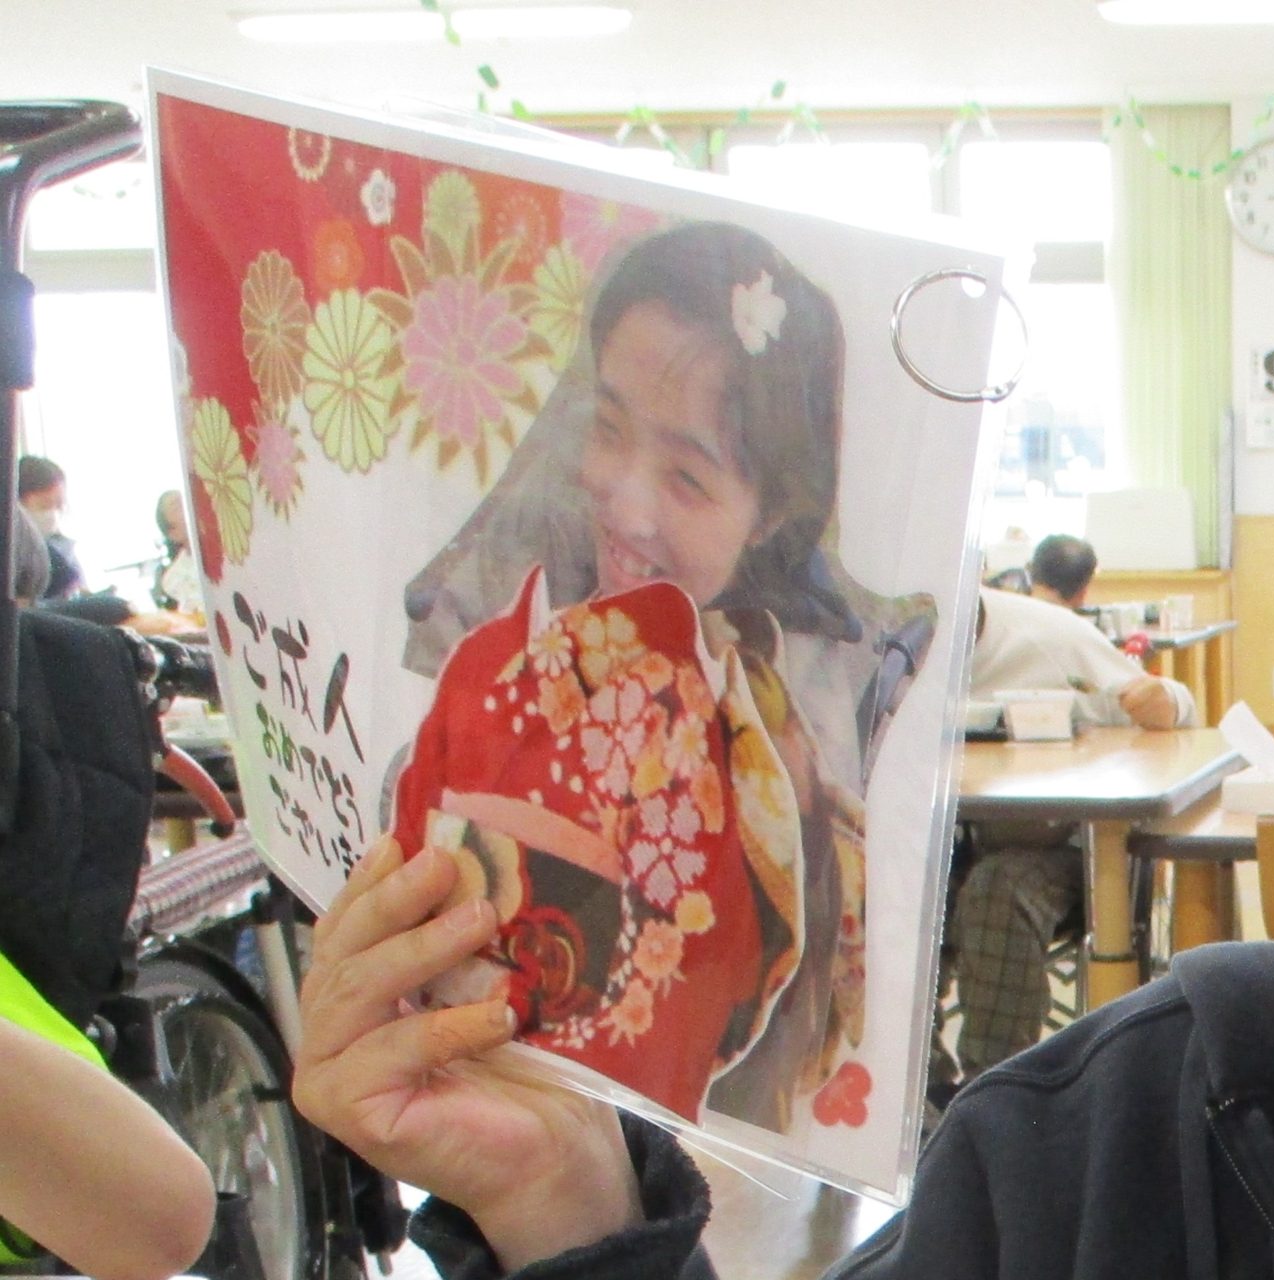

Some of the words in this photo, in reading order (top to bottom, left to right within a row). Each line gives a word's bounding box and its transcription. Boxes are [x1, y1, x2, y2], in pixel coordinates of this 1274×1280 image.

[233, 591, 364, 764] ご成人
[256, 701, 364, 844] おめでとう
